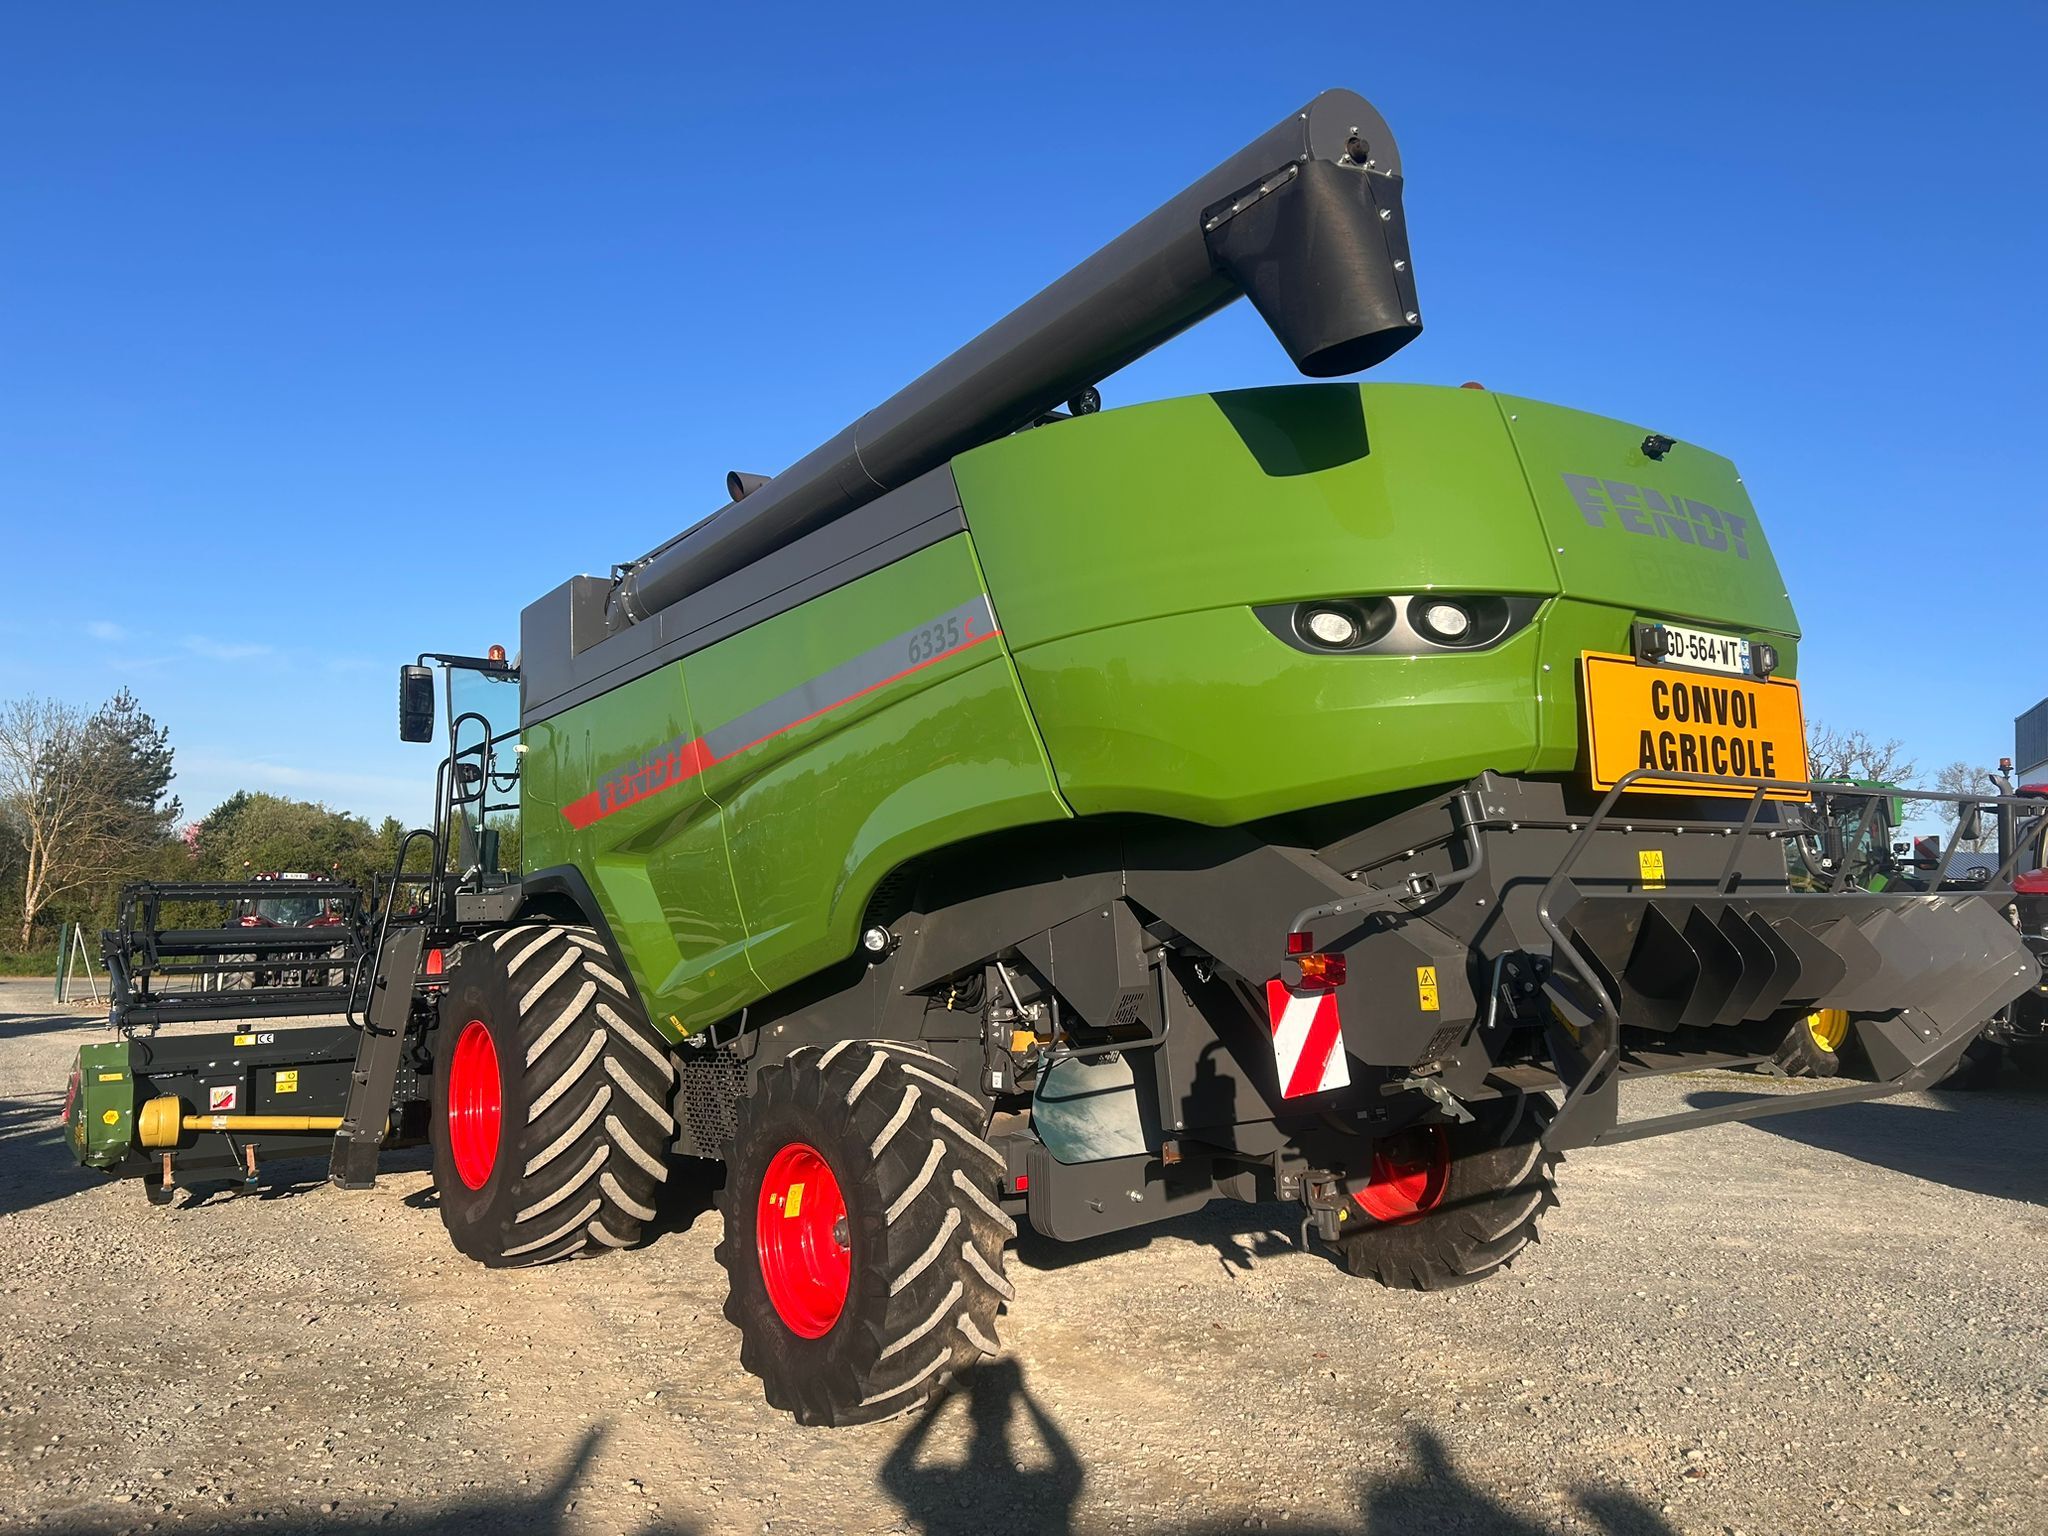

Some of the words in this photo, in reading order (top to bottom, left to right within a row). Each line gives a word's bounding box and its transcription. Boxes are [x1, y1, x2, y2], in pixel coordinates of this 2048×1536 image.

[1562, 473, 1749, 559] FENDT
[908, 616, 960, 665] 6335
[1651, 679, 1757, 729] CONVOI
[597, 732, 688, 814] FENDT
[1638, 730, 1776, 778] AGRICOLE
